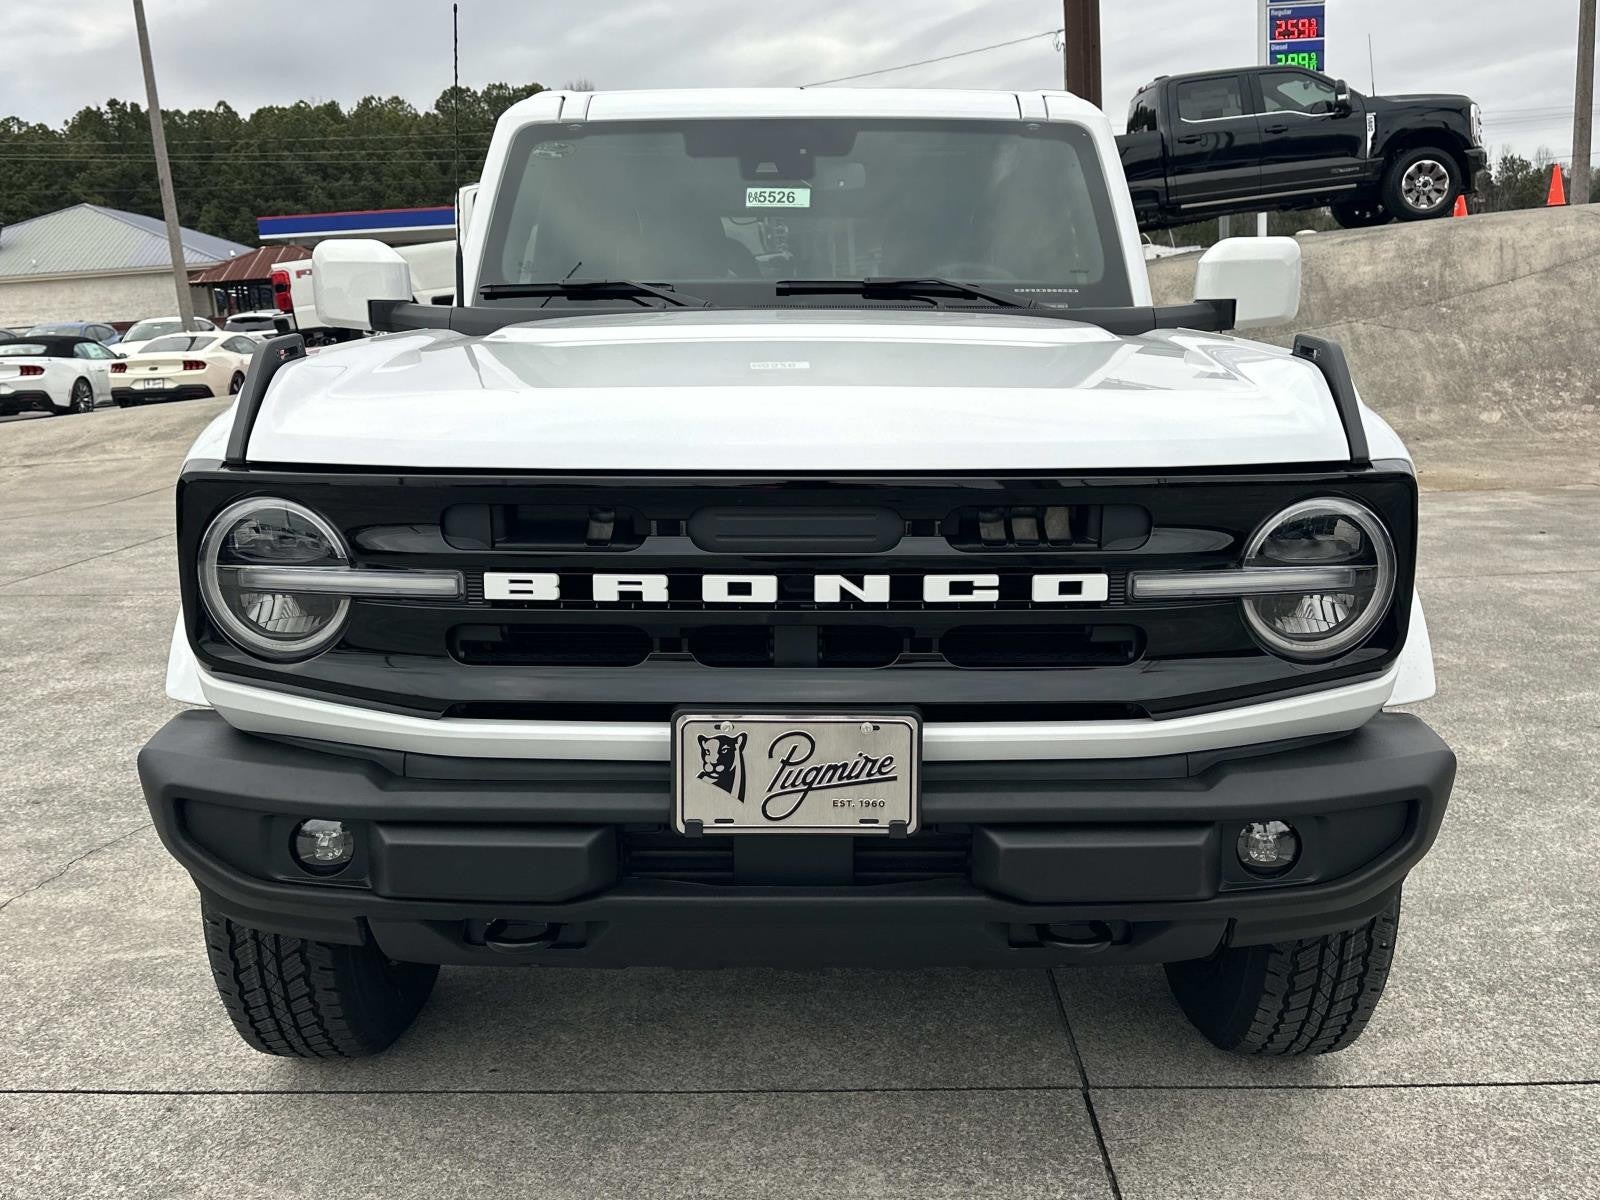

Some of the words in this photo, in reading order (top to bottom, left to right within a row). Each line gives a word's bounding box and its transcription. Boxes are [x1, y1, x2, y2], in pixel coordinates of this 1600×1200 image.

[1270, 8, 1292, 17] Regular
[1275, 18, 1309, 40] 2.59
[1270, 43, 1288, 51] Diesel
[483, 572, 1109, 603] BRONCO
[761, 731, 898, 822] Pugmire
[832, 799, 855, 808] EST.
[859, 799, 886, 808] 1960
